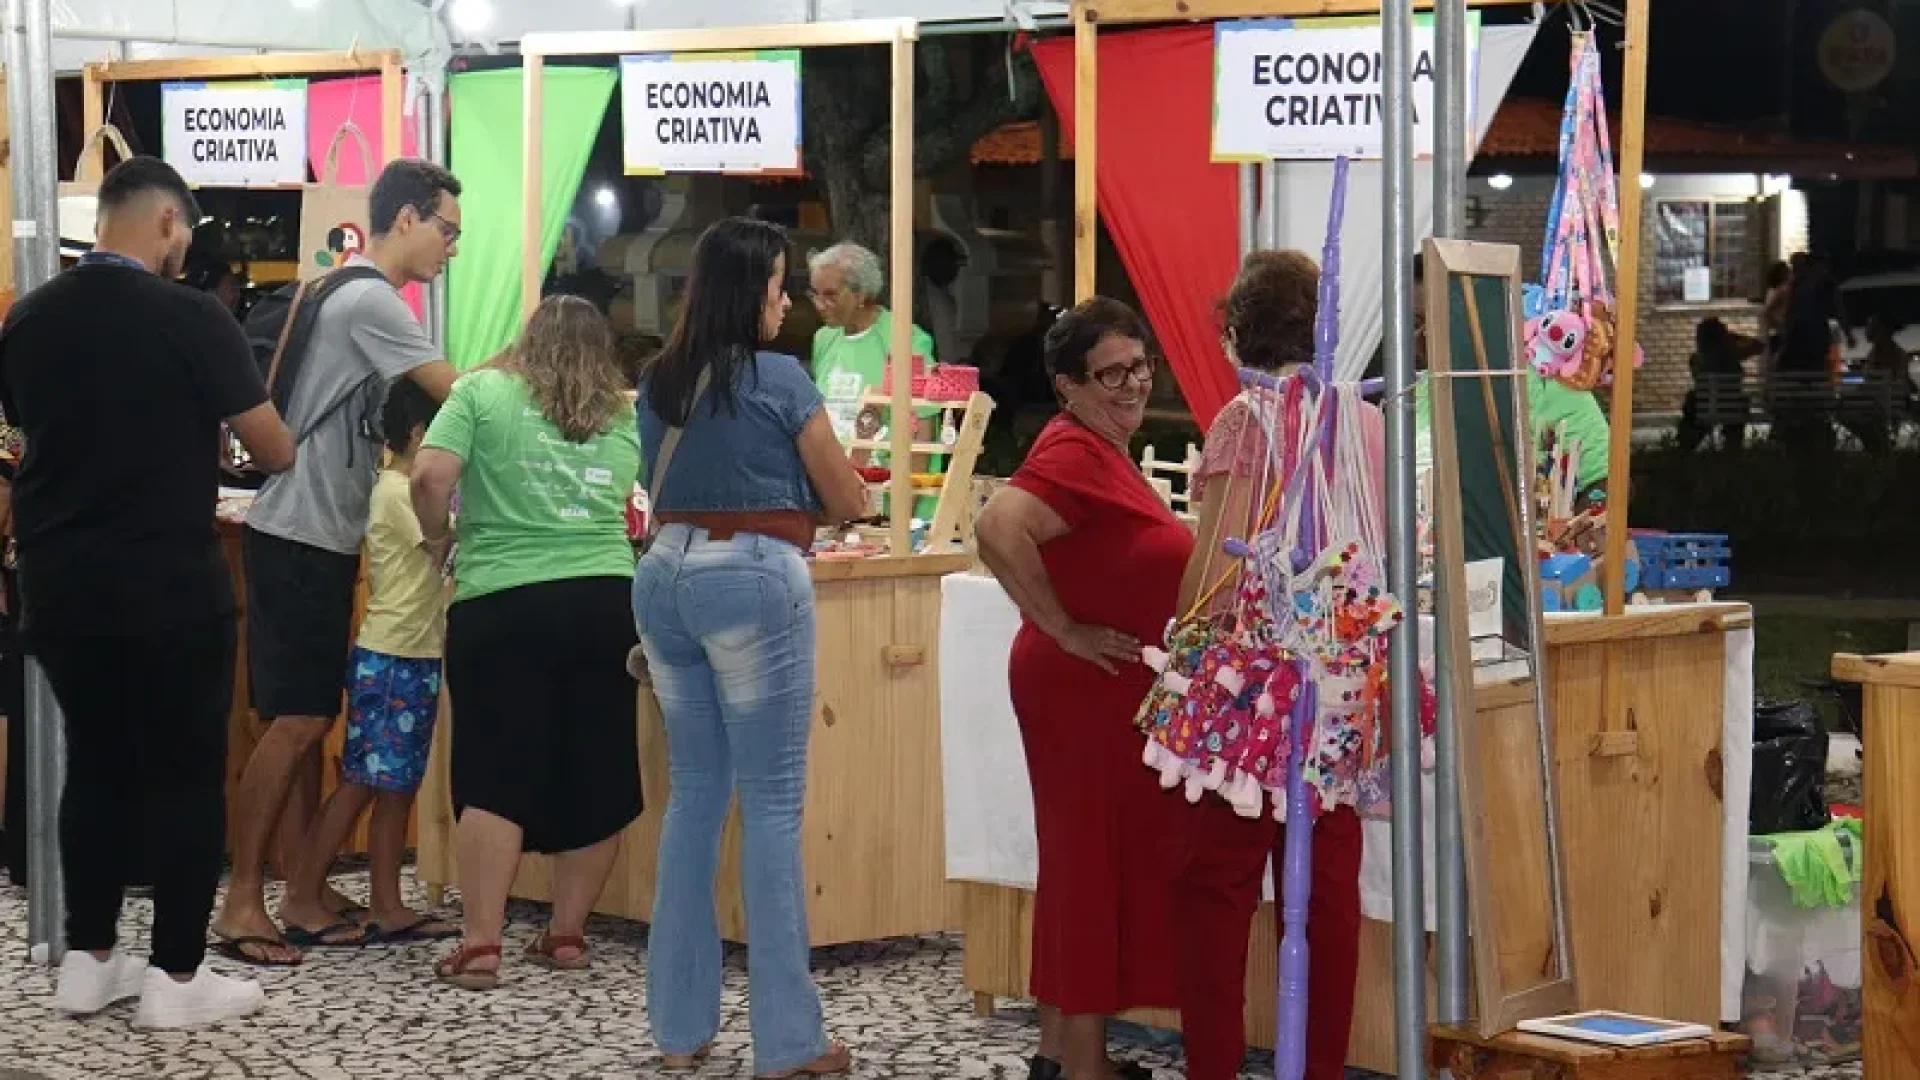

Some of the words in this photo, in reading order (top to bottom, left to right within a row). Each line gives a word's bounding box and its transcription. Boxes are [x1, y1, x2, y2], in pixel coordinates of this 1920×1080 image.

[1253, 50, 1434, 85] ECONOA
[646, 81, 771, 109] ECONOMIA
[184, 107, 286, 132] ECONOMIA
[1265, 94, 1419, 126] CRIATI
[657, 117, 762, 144] CRIATIVA
[192, 138, 279, 163] CRIATIVA
